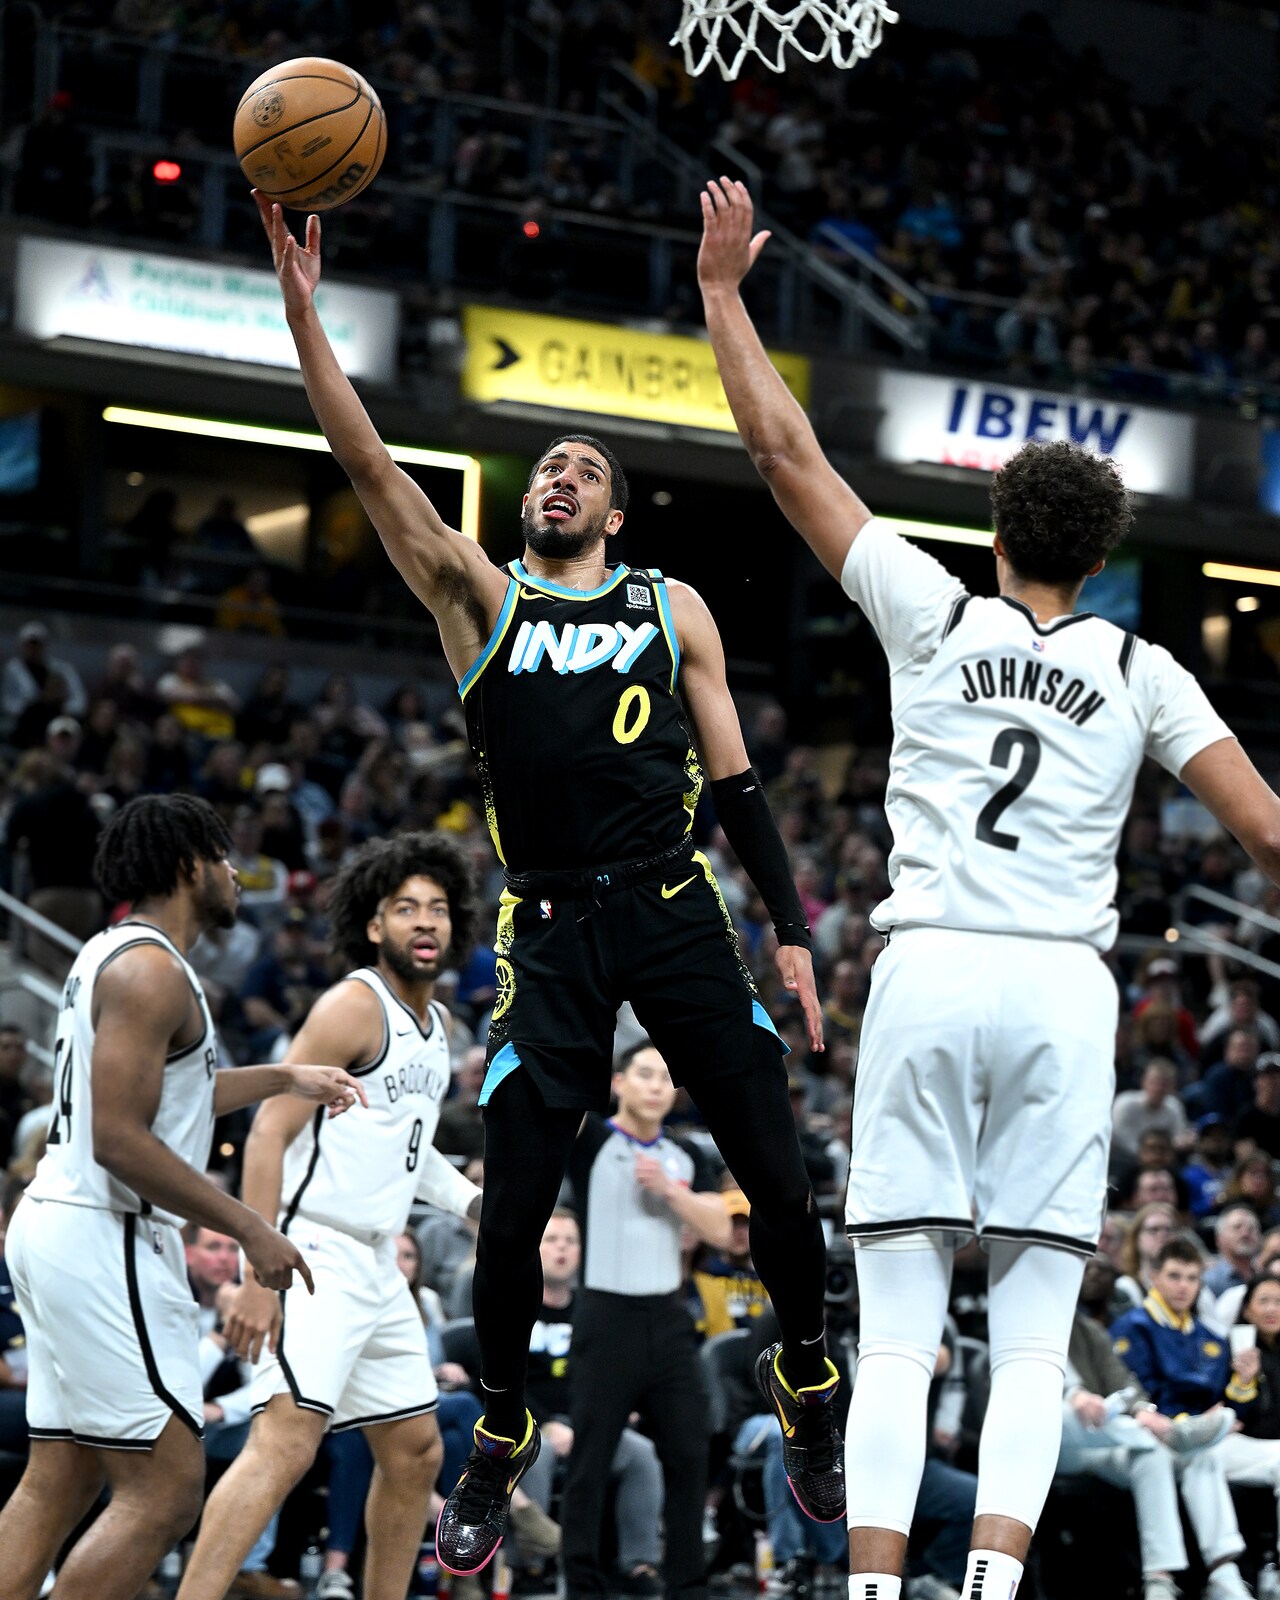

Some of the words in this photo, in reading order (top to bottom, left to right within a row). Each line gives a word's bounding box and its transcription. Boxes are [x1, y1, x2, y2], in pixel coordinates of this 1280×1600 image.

[947, 388, 1129, 455] IBEW
[508, 620, 660, 676] INDY
[612, 685, 651, 745] 0
[961, 657, 1106, 727] JOHNSON
[975, 727, 1042, 853] 2
[406, 1118, 423, 1173] 9
